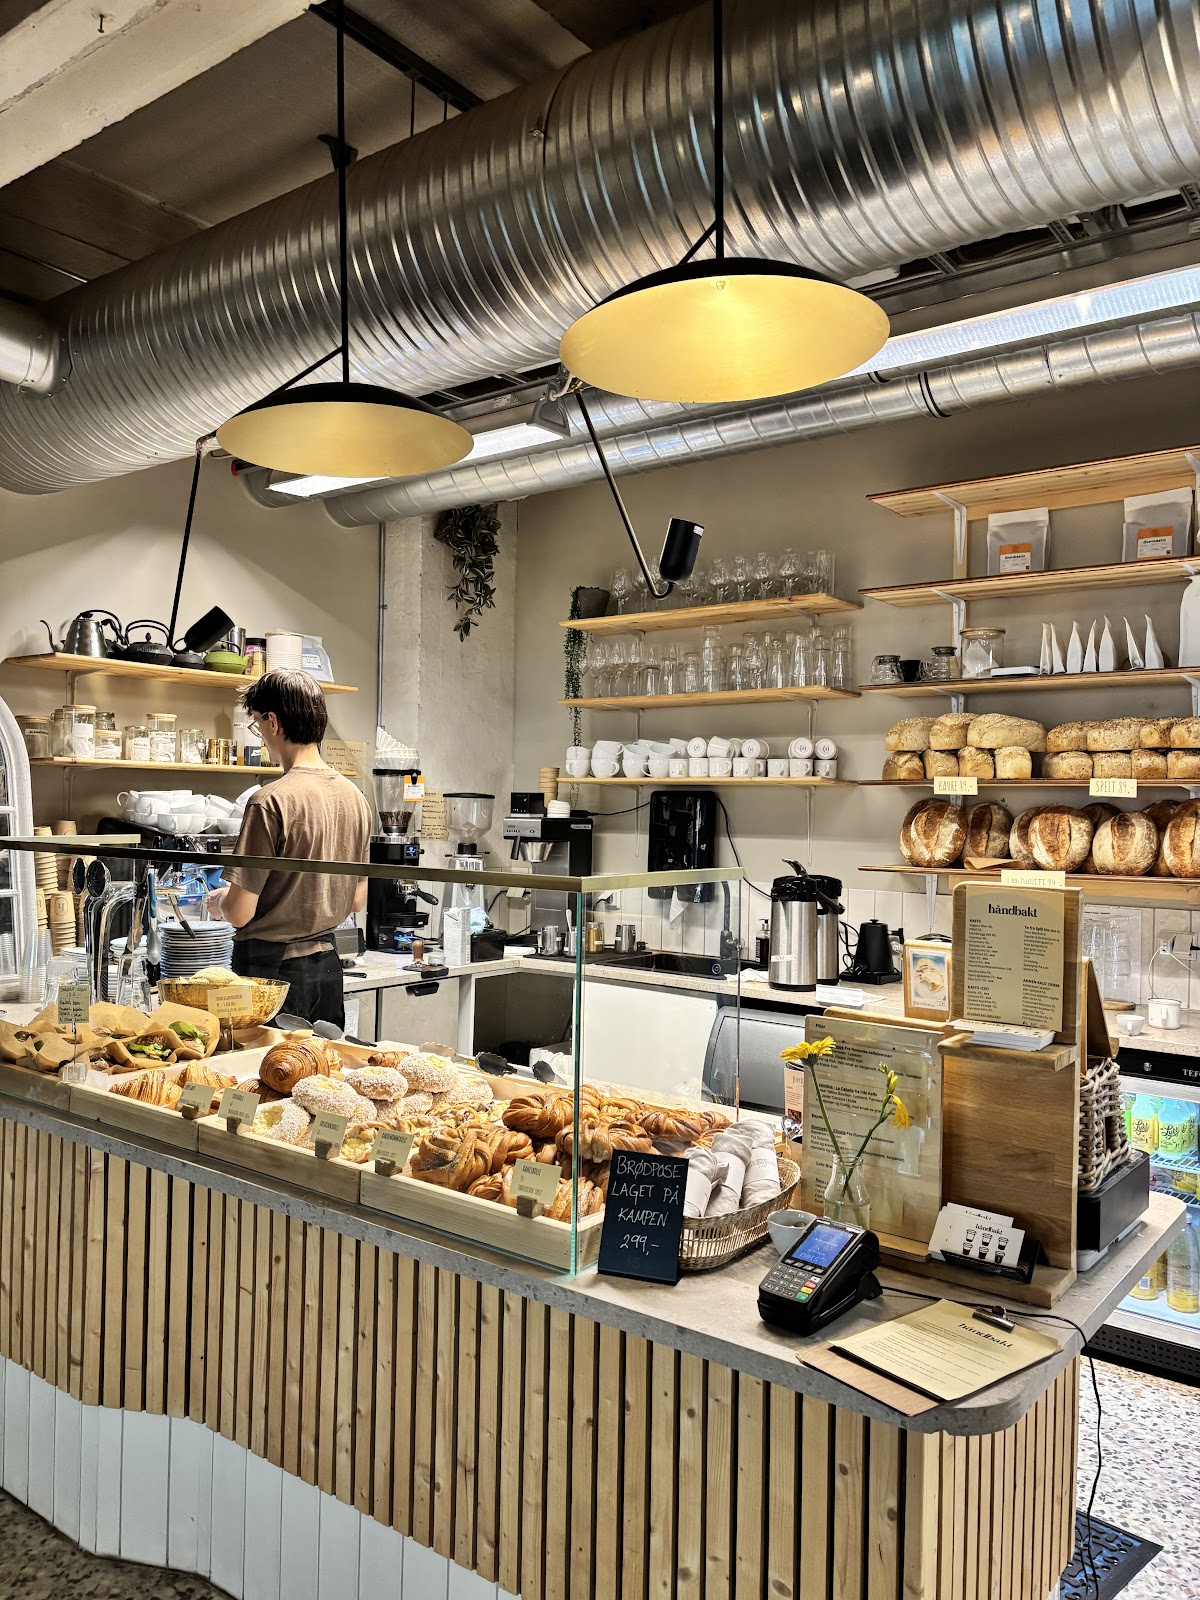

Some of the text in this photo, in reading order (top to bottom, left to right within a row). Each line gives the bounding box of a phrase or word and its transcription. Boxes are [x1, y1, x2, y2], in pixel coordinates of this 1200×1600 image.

[938, 780, 958, 792] HAVRE
[1095, 780, 1116, 793] SPELT
[988, 903, 1038, 918] håndbakt
[616, 1155, 685, 1179] BRØDPOSE
[611, 1182, 679, 1206] LAGET PÅ
[617, 1207, 670, 1227] KAMPEN
[619, 1233, 660, 1256] 299,-
[799, 1251, 820, 1263] nets
[958, 1322, 1014, 1349] håndbakt
